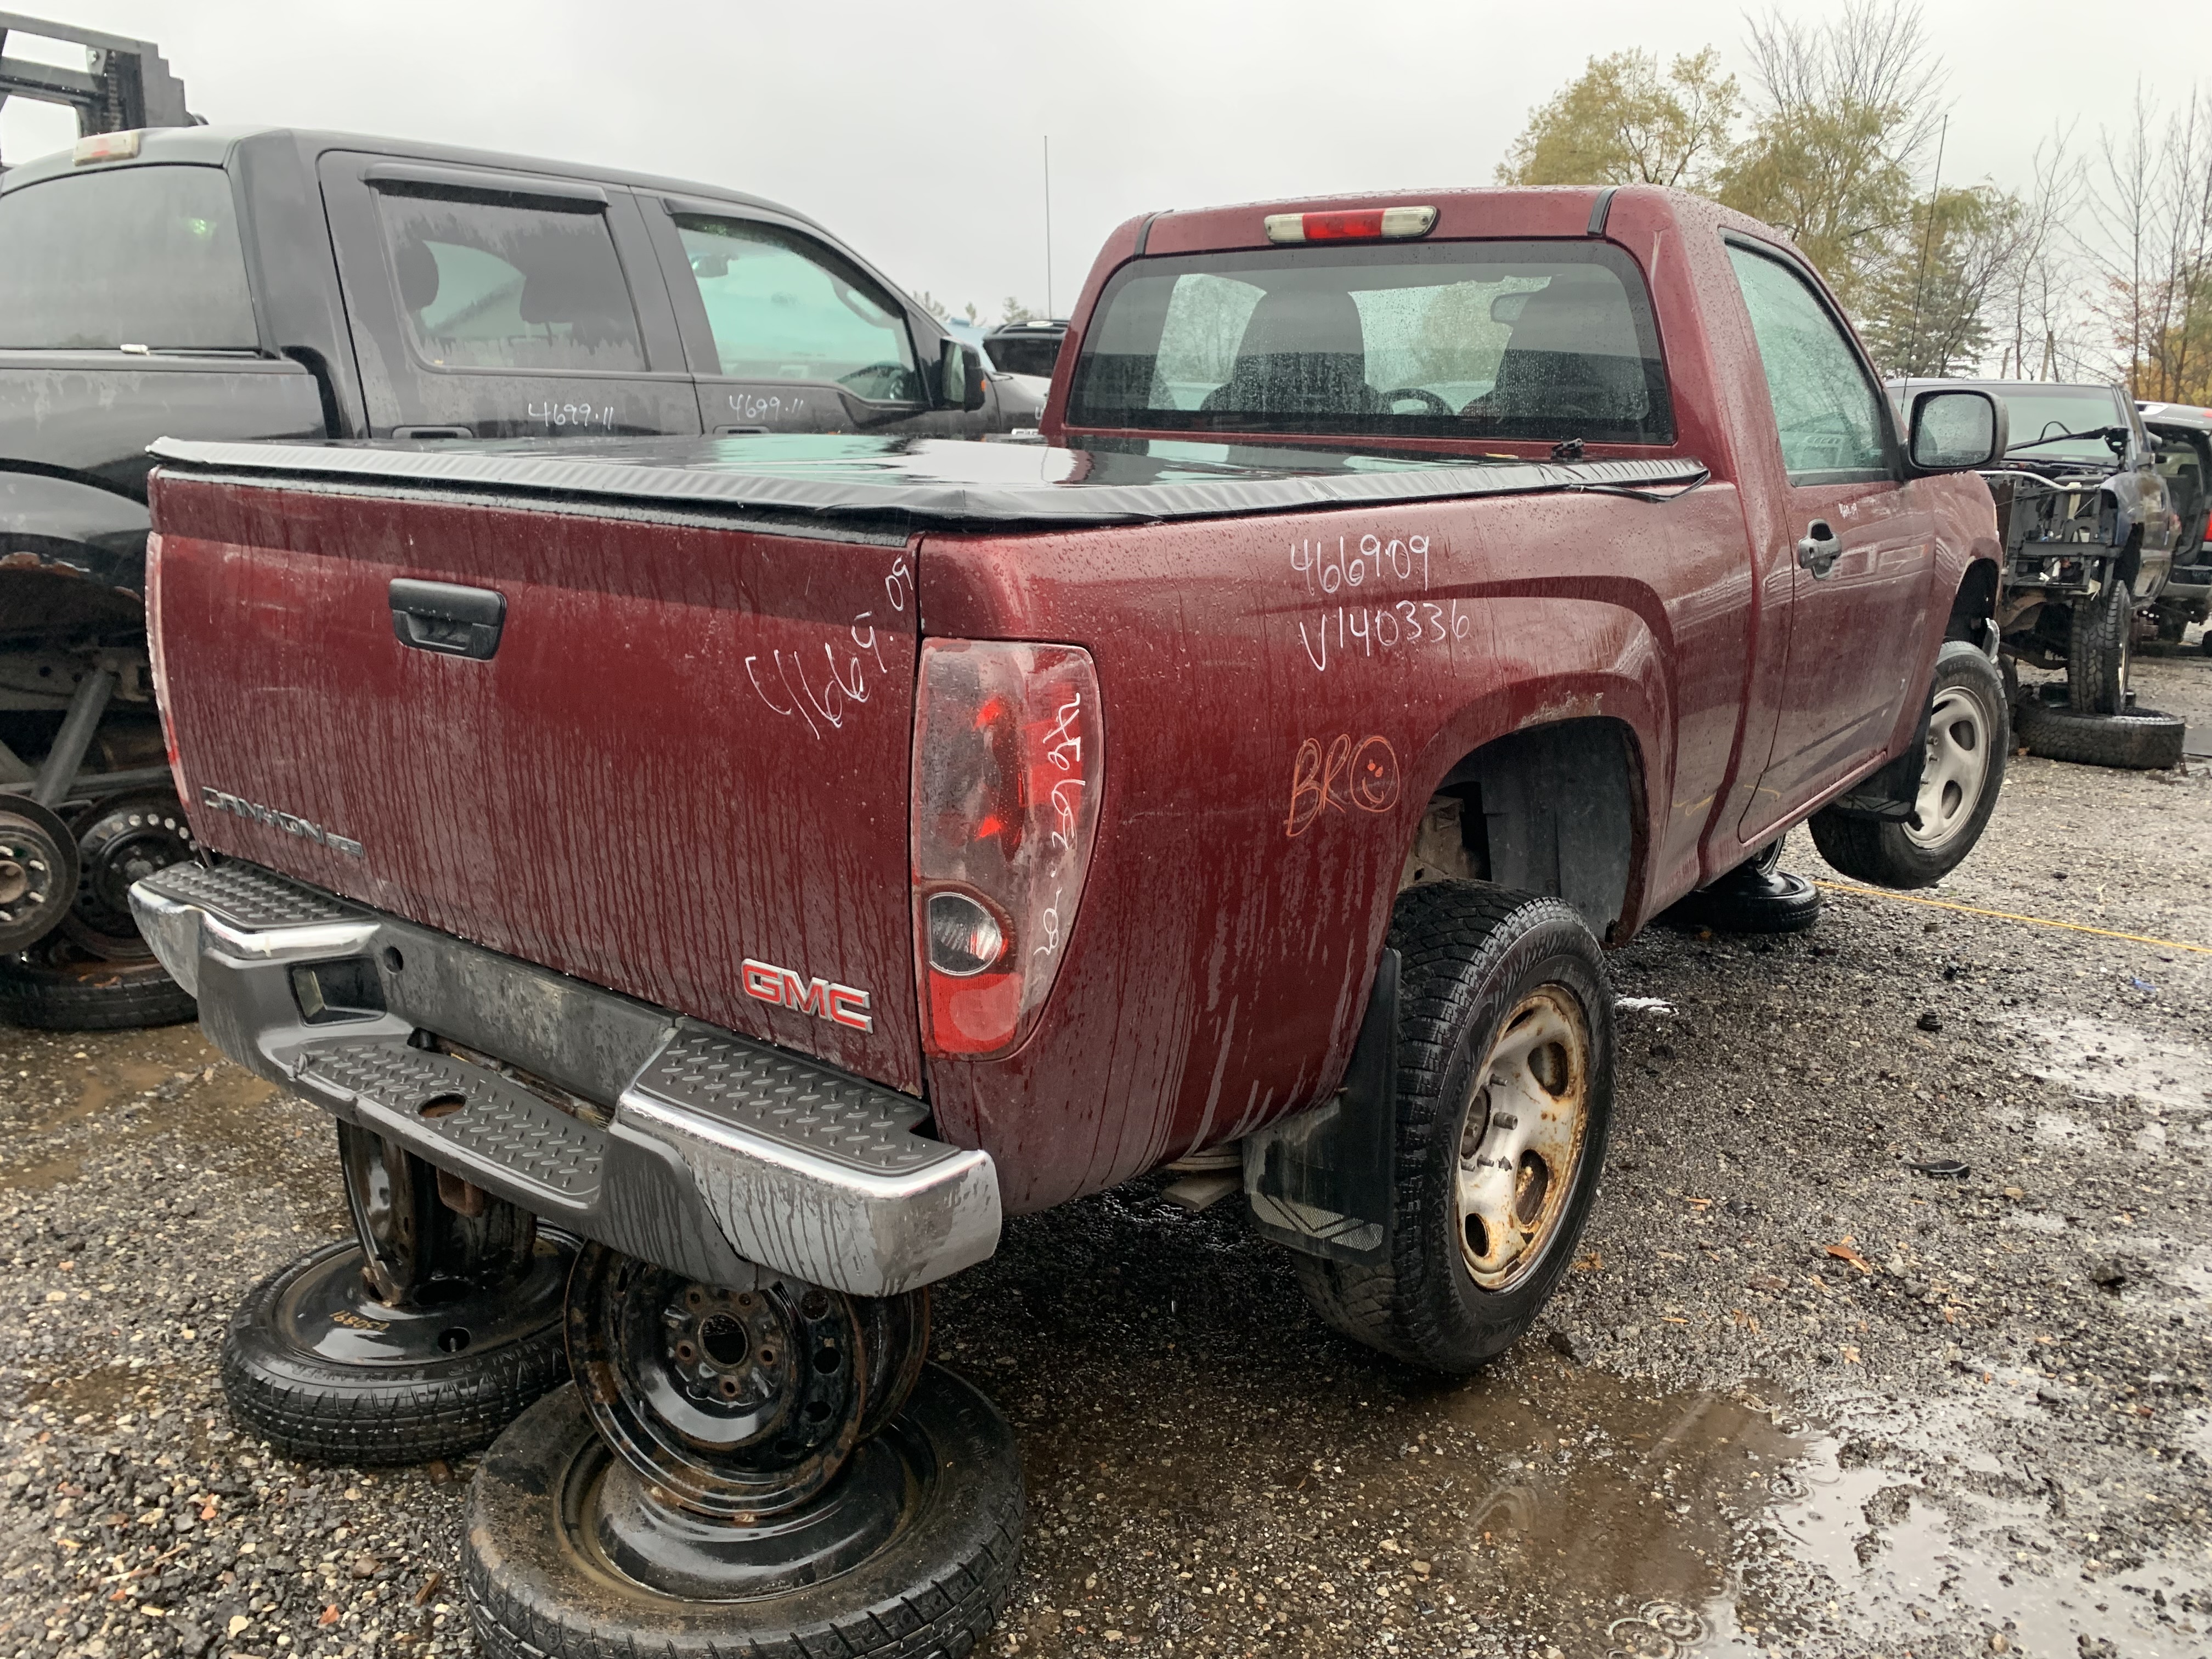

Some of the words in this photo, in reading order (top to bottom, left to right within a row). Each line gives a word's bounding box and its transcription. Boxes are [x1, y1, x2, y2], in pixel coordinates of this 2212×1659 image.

[527, 401, 614, 430] 4699.11
[729, 393, 804, 421] 4699.11
[741, 958, 874, 1034] GMC
